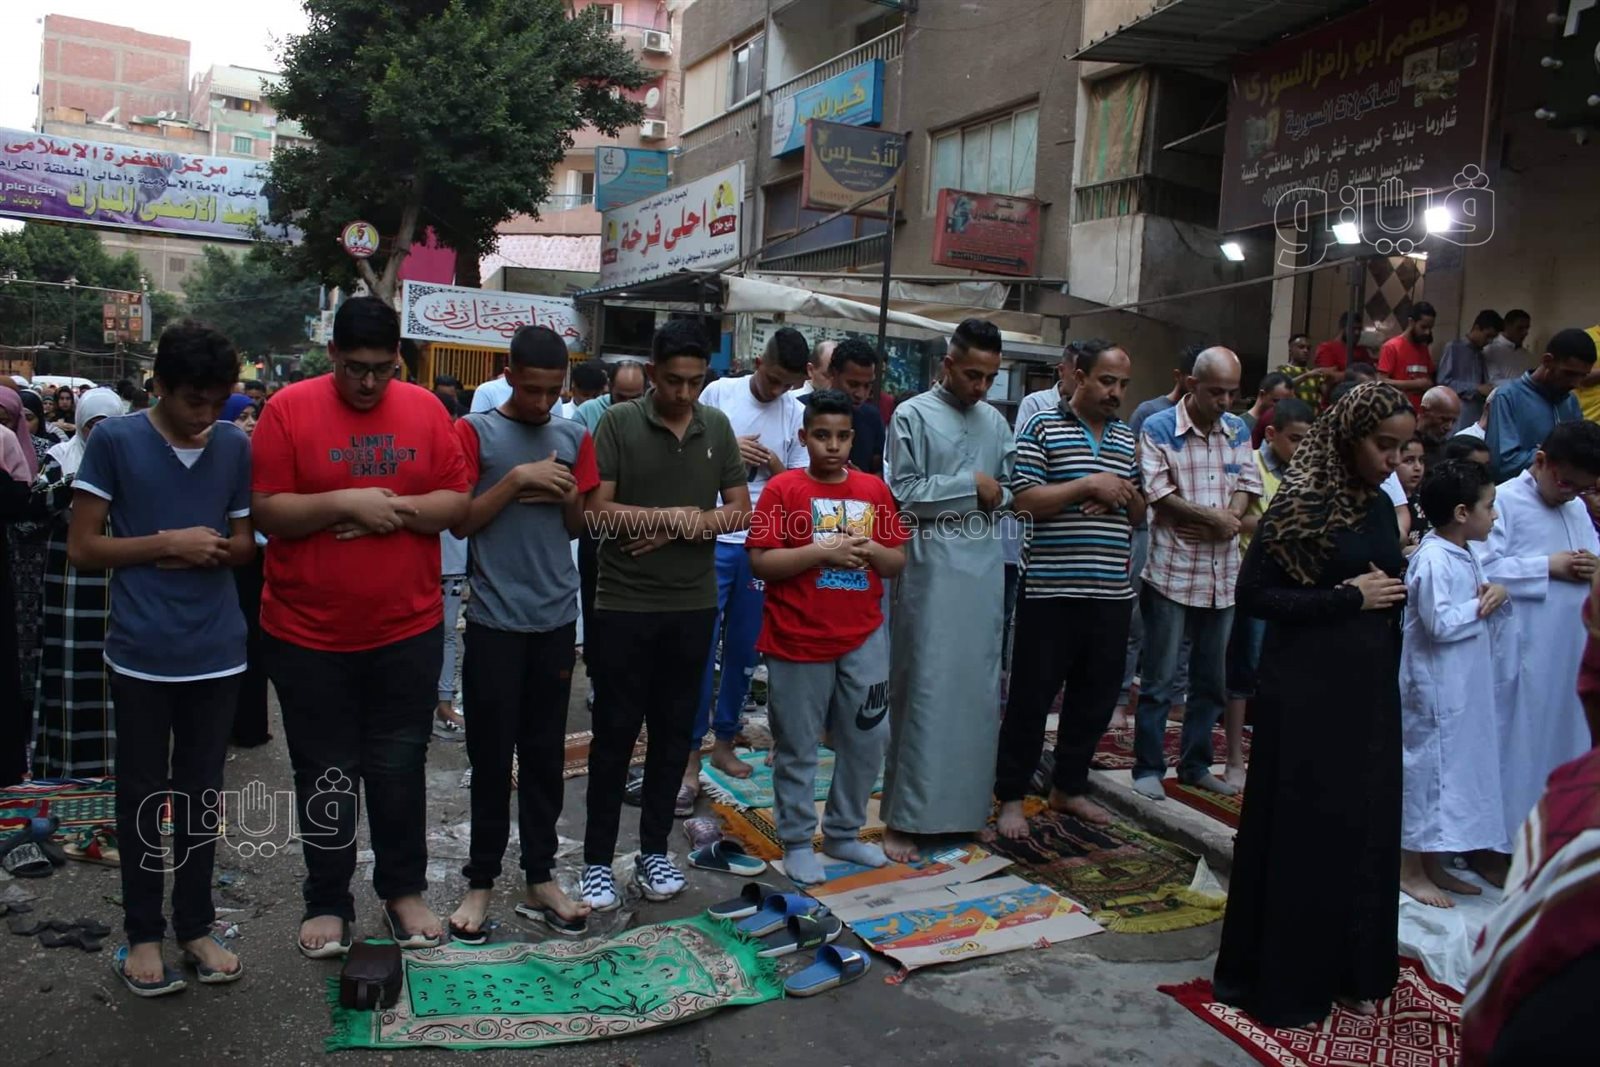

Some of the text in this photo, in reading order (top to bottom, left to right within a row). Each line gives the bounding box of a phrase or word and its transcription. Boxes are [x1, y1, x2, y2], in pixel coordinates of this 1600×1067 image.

[1385, 2, 1470, 64] مطعم
[1425, 106, 1458, 135] شاورما
[4, 137, 98, 162] الإسلامى
[104, 147, 173, 168] المغفرة
[44, 162, 90, 177] المنطقة
[175, 157, 228, 177] مركز
[1348, 153, 1425, 186] خدمة توصيل الطلبات
[66, 181, 136, 217] المبارك
[621, 197, 706, 257] احلى فرخة
[351, 434, 395, 448] LIMIT
[330, 448, 416, 462] DOES NOT
[351, 462, 398, 476] EXIST
